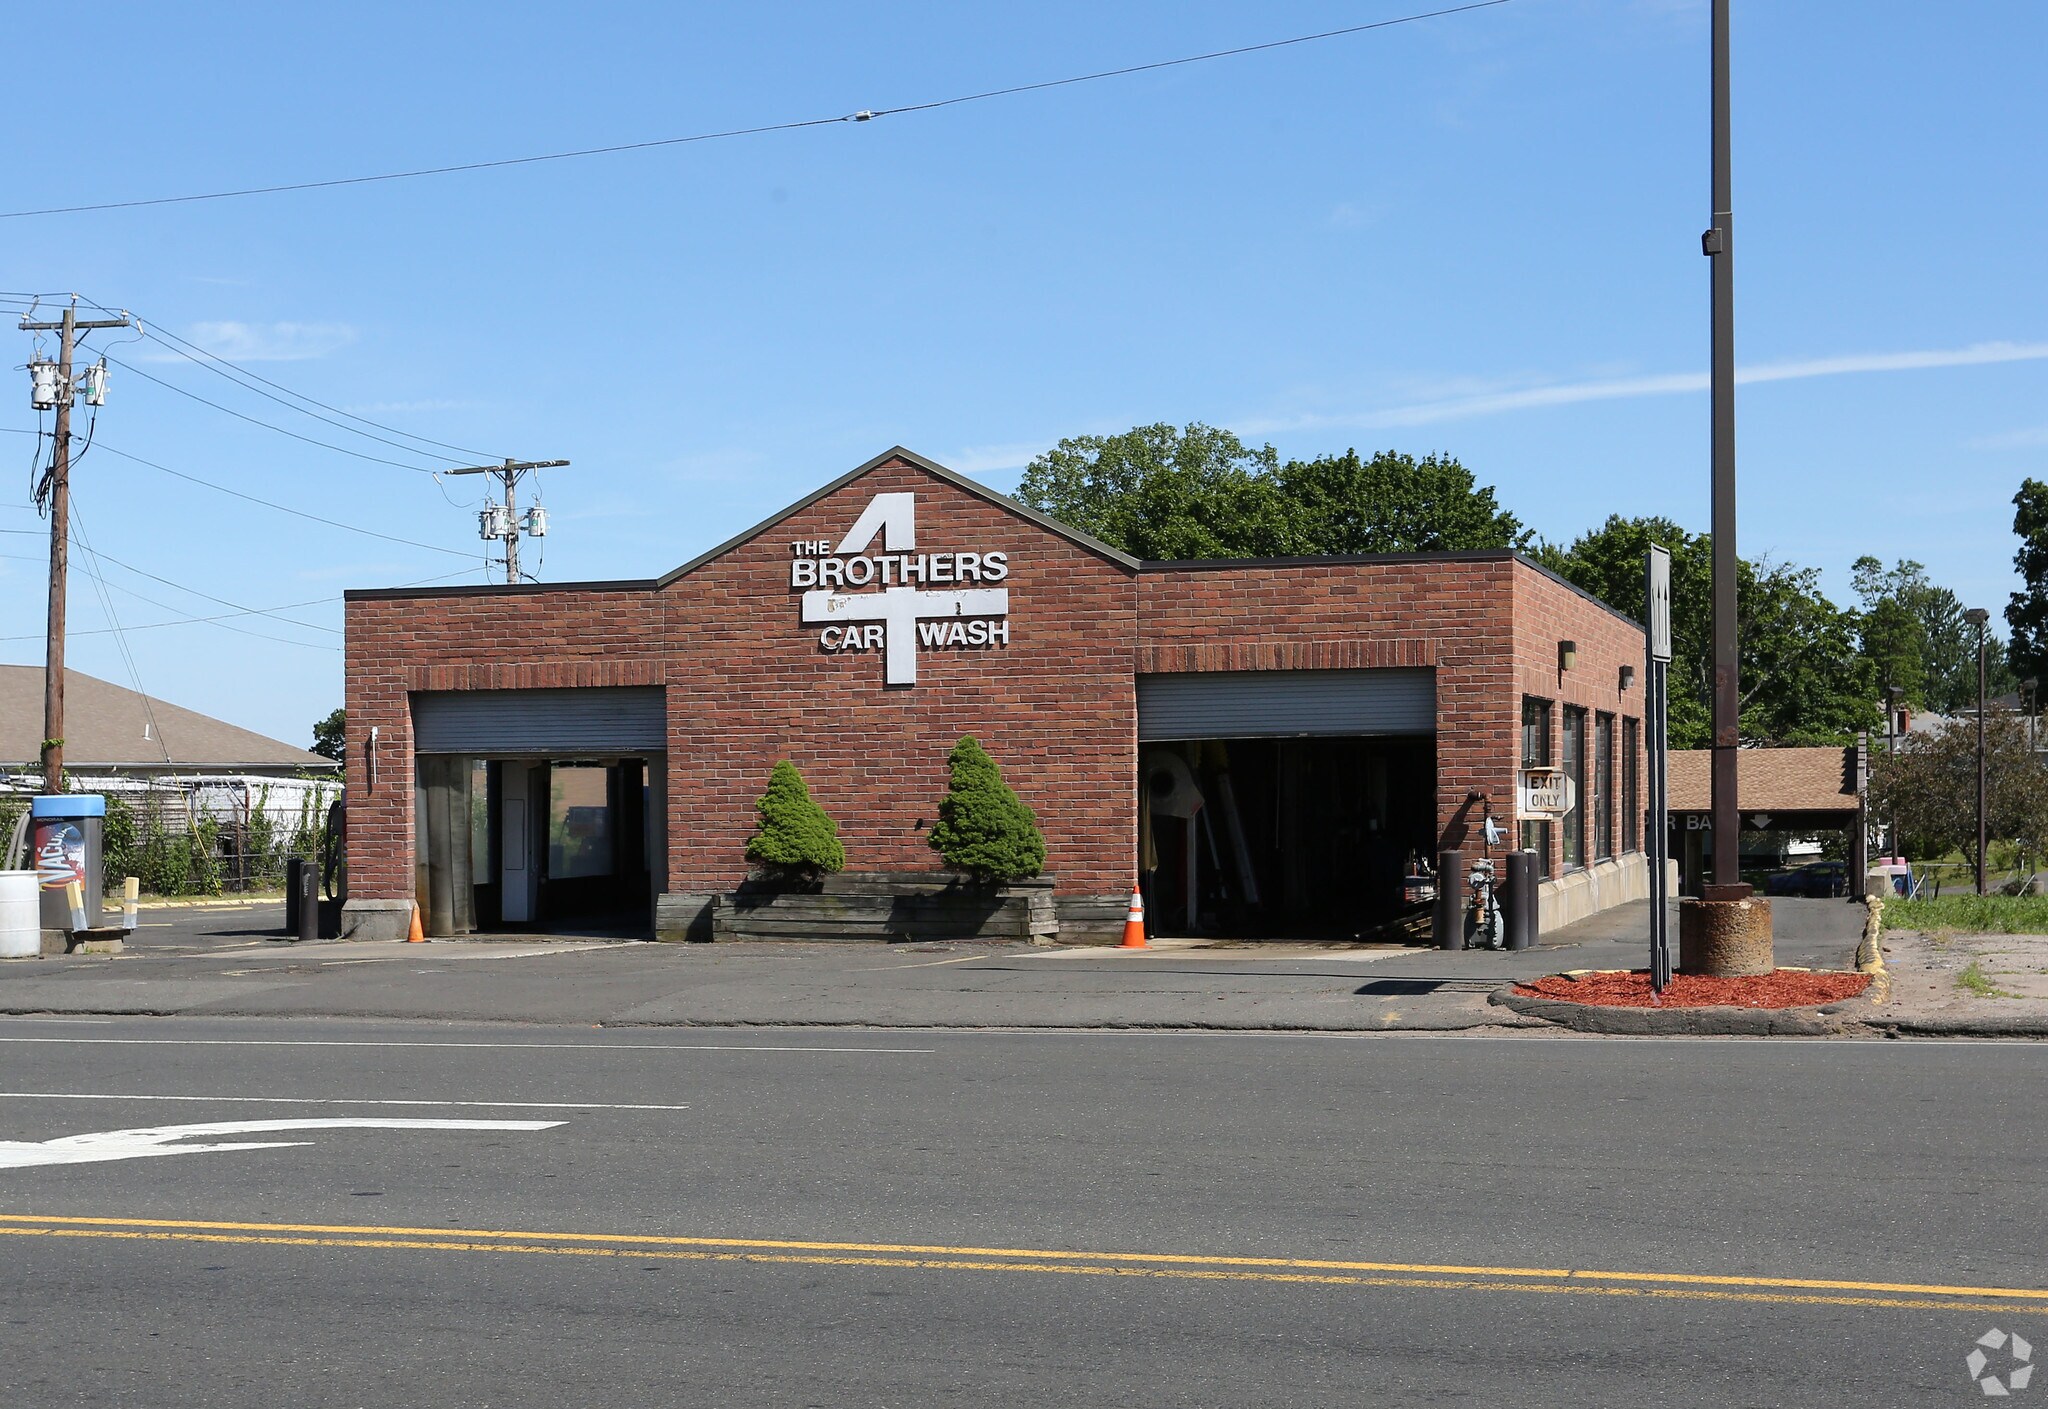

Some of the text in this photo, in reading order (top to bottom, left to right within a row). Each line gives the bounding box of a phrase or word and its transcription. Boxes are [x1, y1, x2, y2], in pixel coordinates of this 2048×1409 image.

[791, 540, 830, 556] THE
[792, 551, 1009, 587] BROTHERS
[802, 491, 1009, 685] 4
[820, 620, 1009, 650] CAR WASH
[1530, 776, 1562, 790] EXIT
[1531, 793, 1560, 807] ONLY
[1686, 814, 1713, 830] BA
